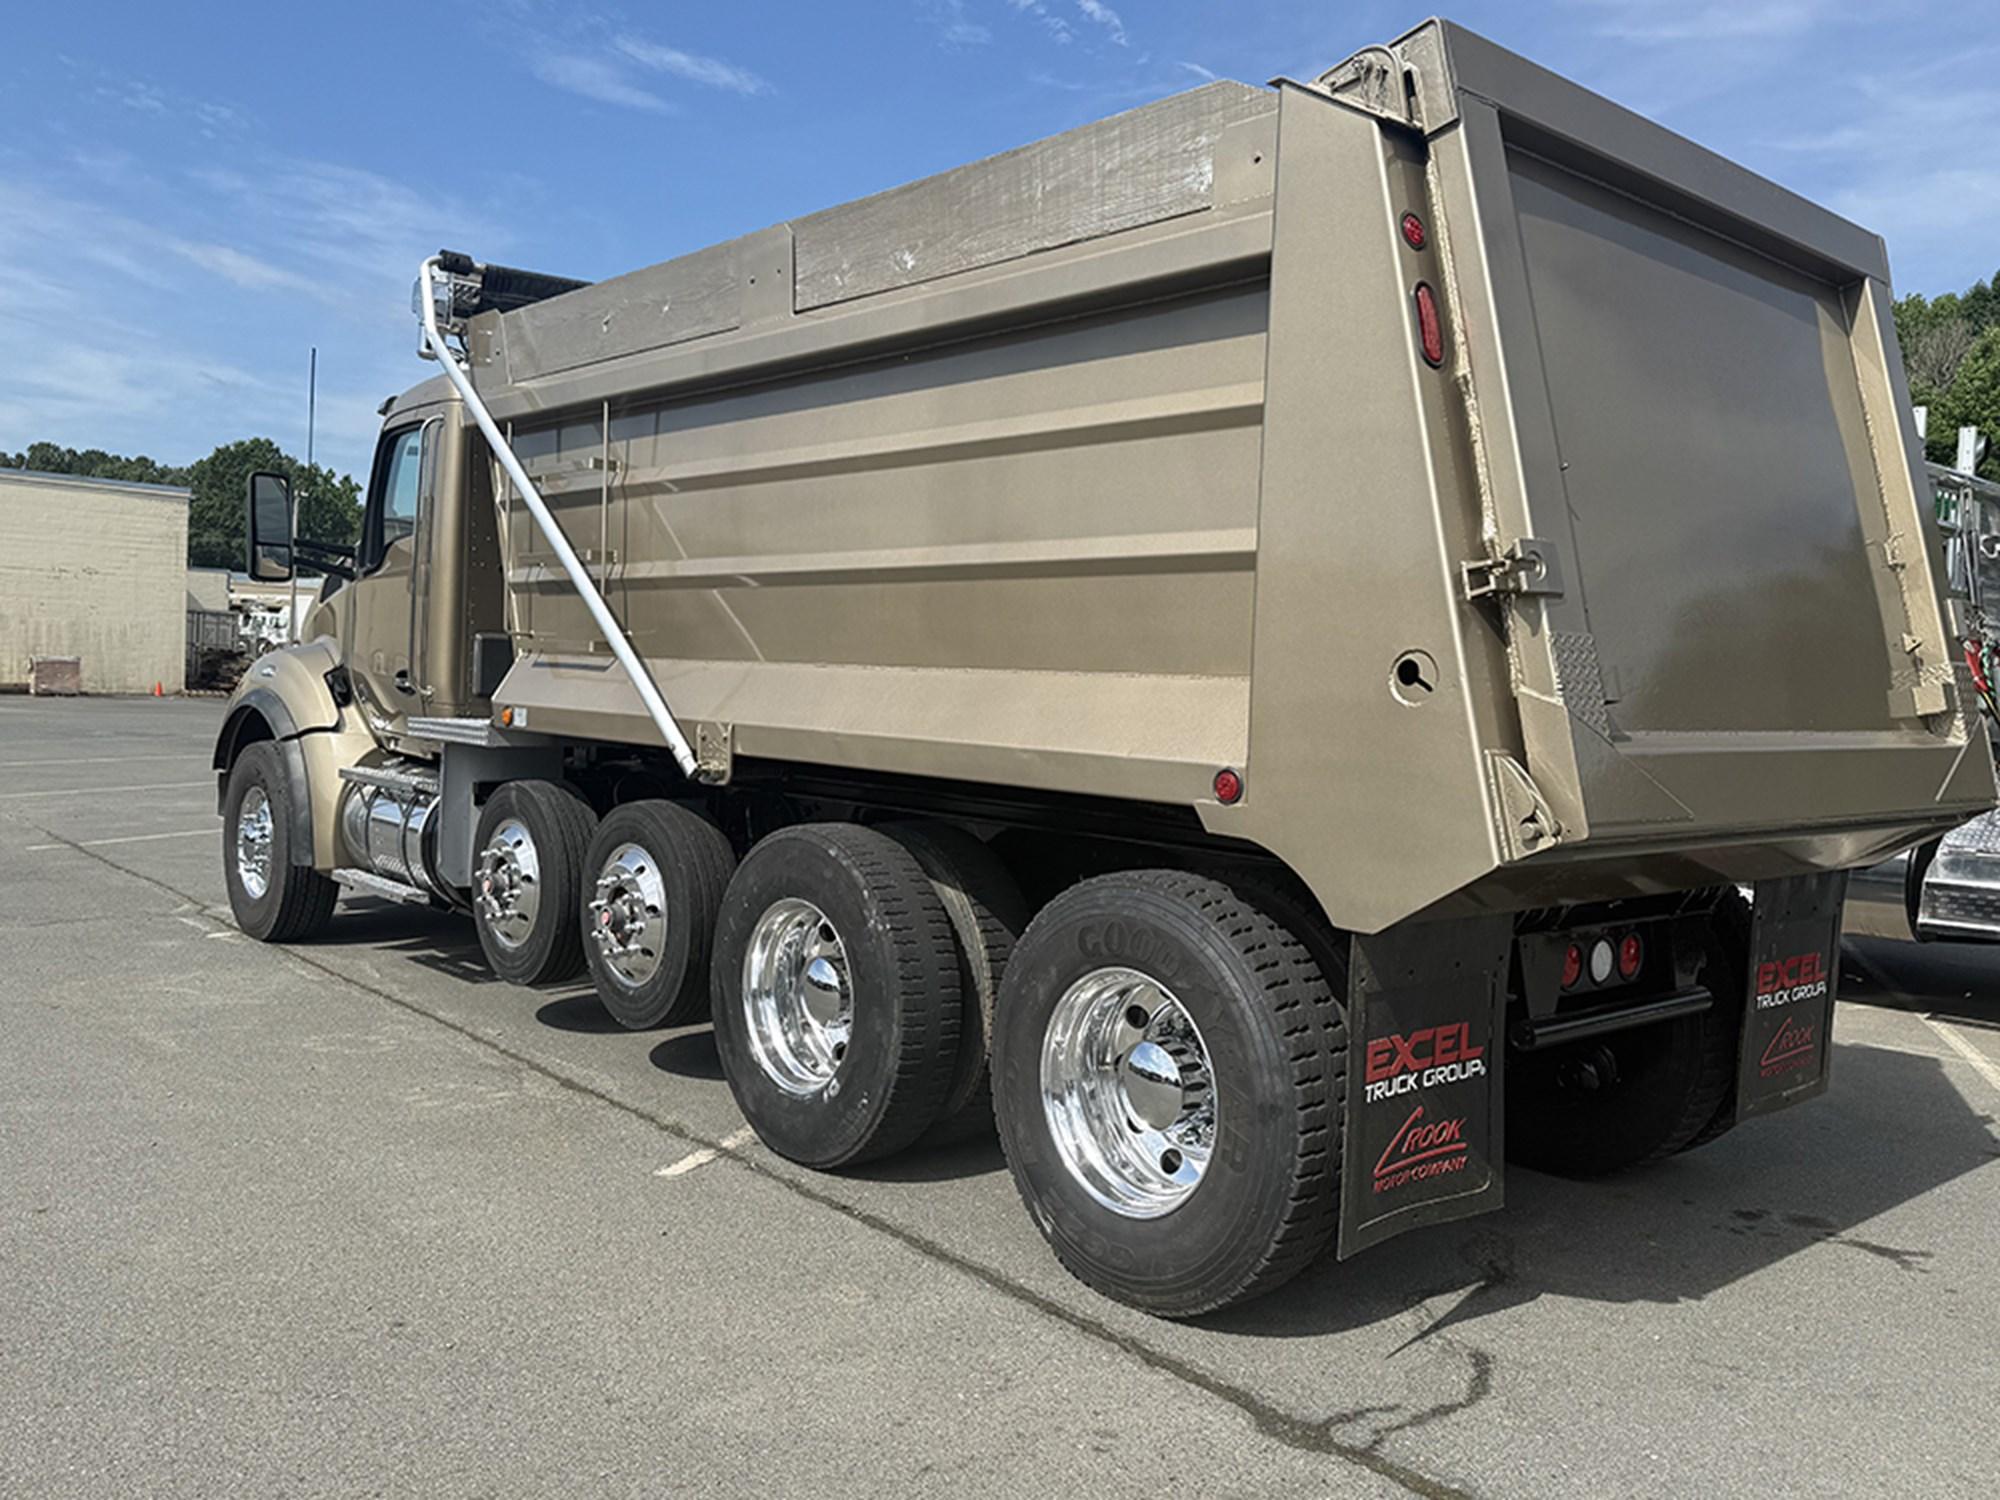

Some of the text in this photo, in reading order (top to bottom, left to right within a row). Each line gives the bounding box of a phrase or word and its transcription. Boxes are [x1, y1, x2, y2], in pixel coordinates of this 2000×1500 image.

[1757, 952, 1826, 994] EXCEL
[1756, 990, 1790, 1009] TRUCK
[1365, 1022, 1484, 1083] EXCEL
[1364, 1072, 1418, 1103] TRUCK
[1411, 1155, 1468, 1182] COMPANY
